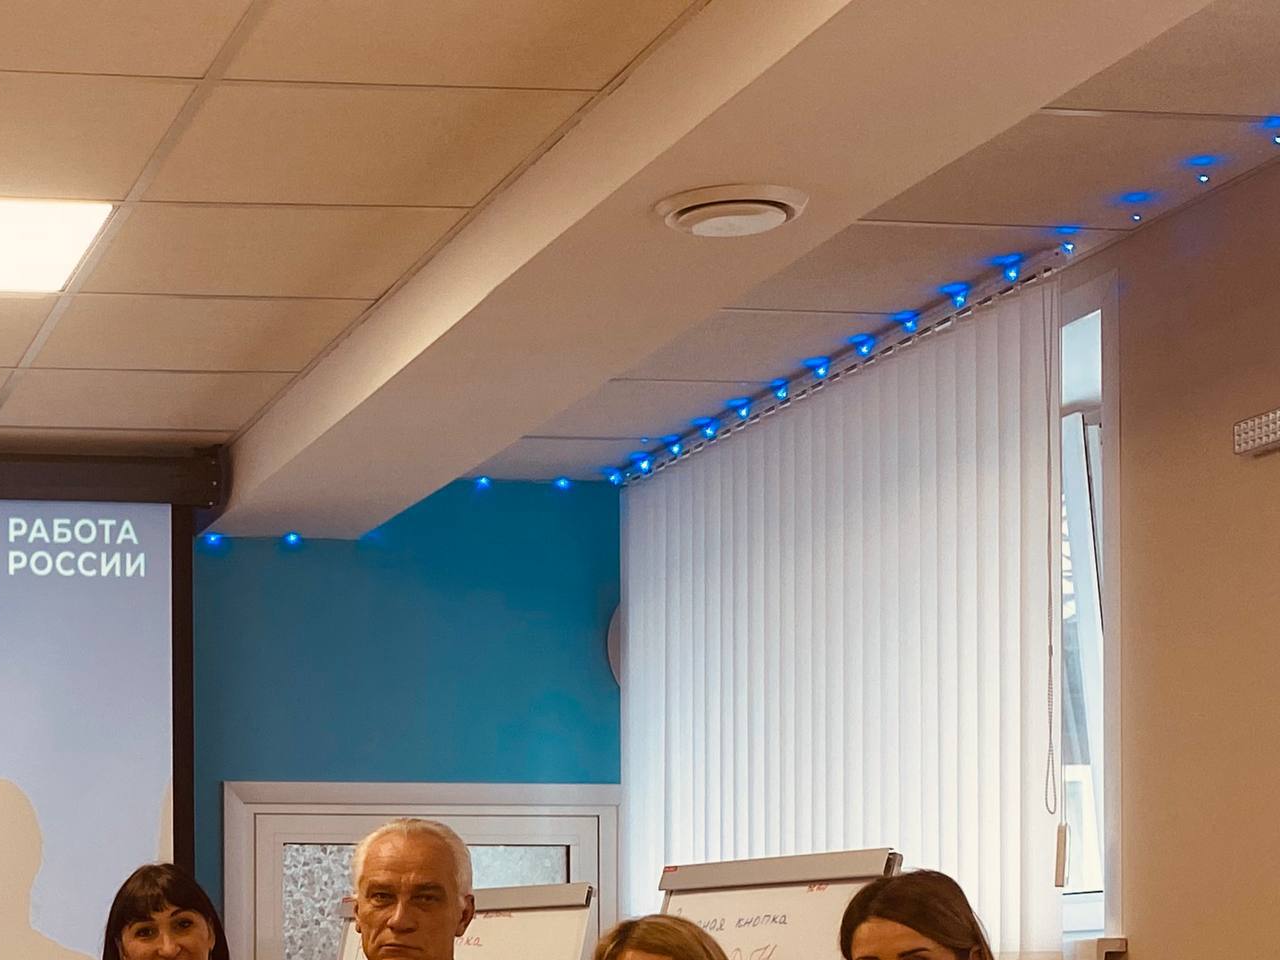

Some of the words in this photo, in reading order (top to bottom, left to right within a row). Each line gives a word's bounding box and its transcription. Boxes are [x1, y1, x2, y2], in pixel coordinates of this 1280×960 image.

[8, 517, 138, 545] РАБОТА
[8, 550, 145, 577] РОССИИ
[735, 913, 789, 929] кнопка
